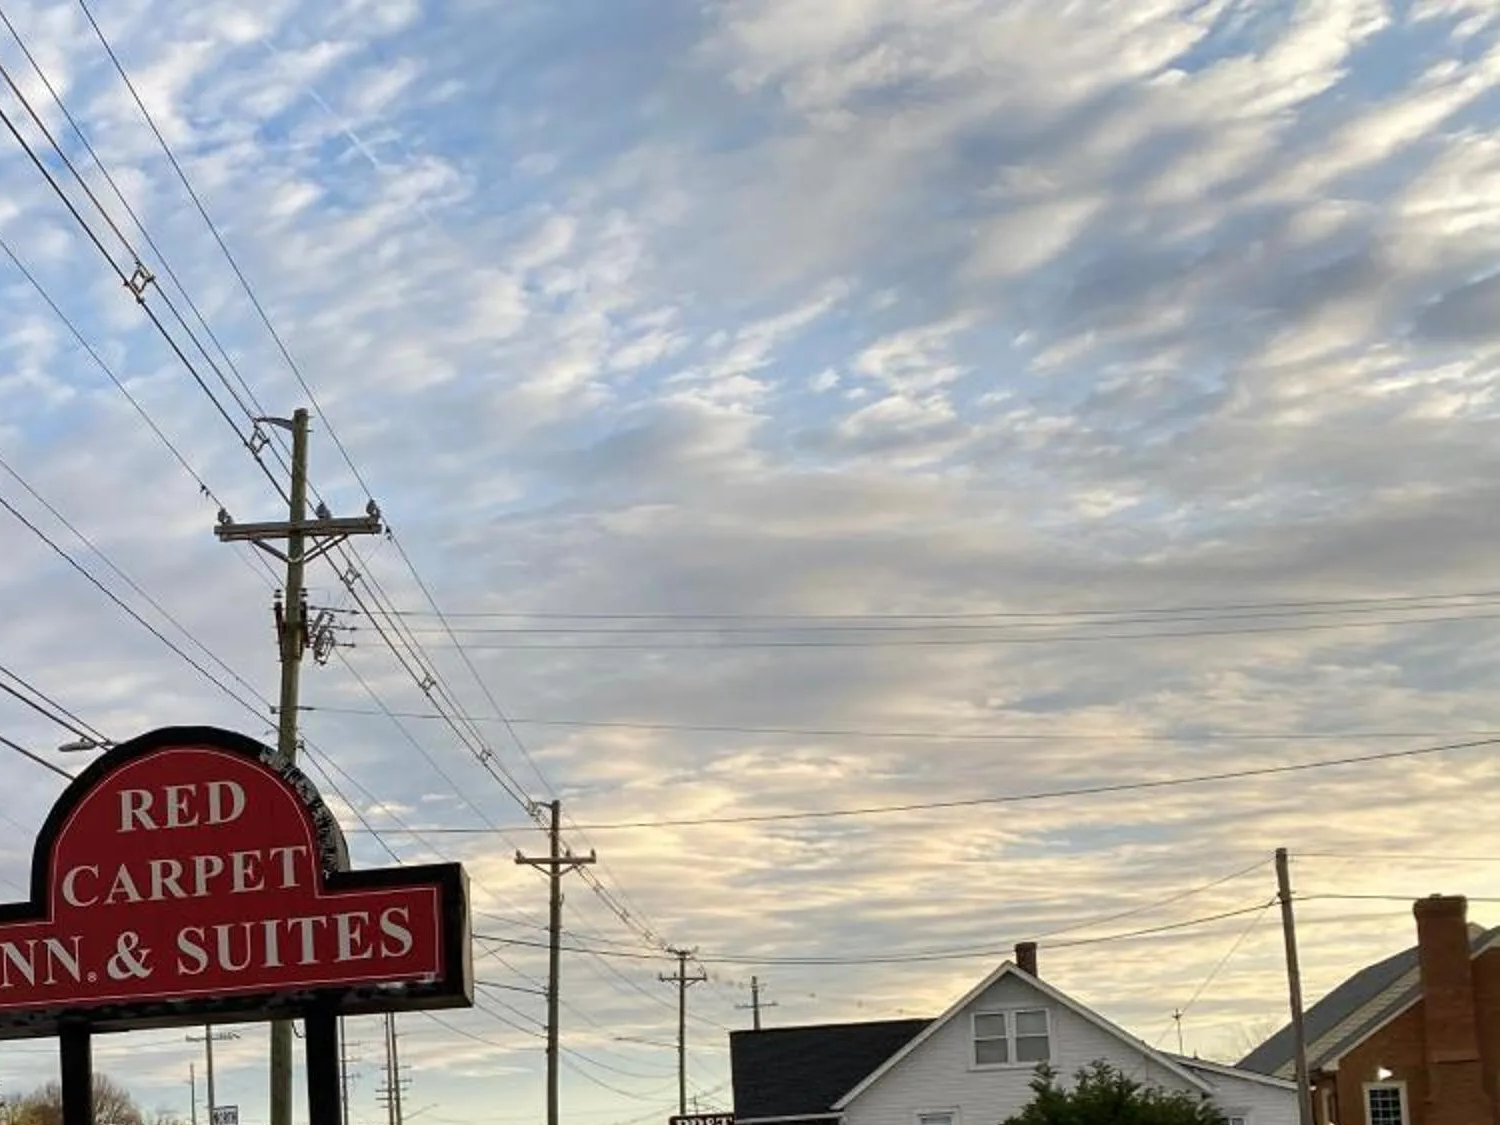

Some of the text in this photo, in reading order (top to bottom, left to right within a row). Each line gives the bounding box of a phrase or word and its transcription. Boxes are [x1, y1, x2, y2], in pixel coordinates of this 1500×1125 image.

[116, 780, 247, 833] RED
[61, 845, 307, 907] CARPET
[106, 931, 154, 981] &
[176, 906, 414, 976] SUITES
